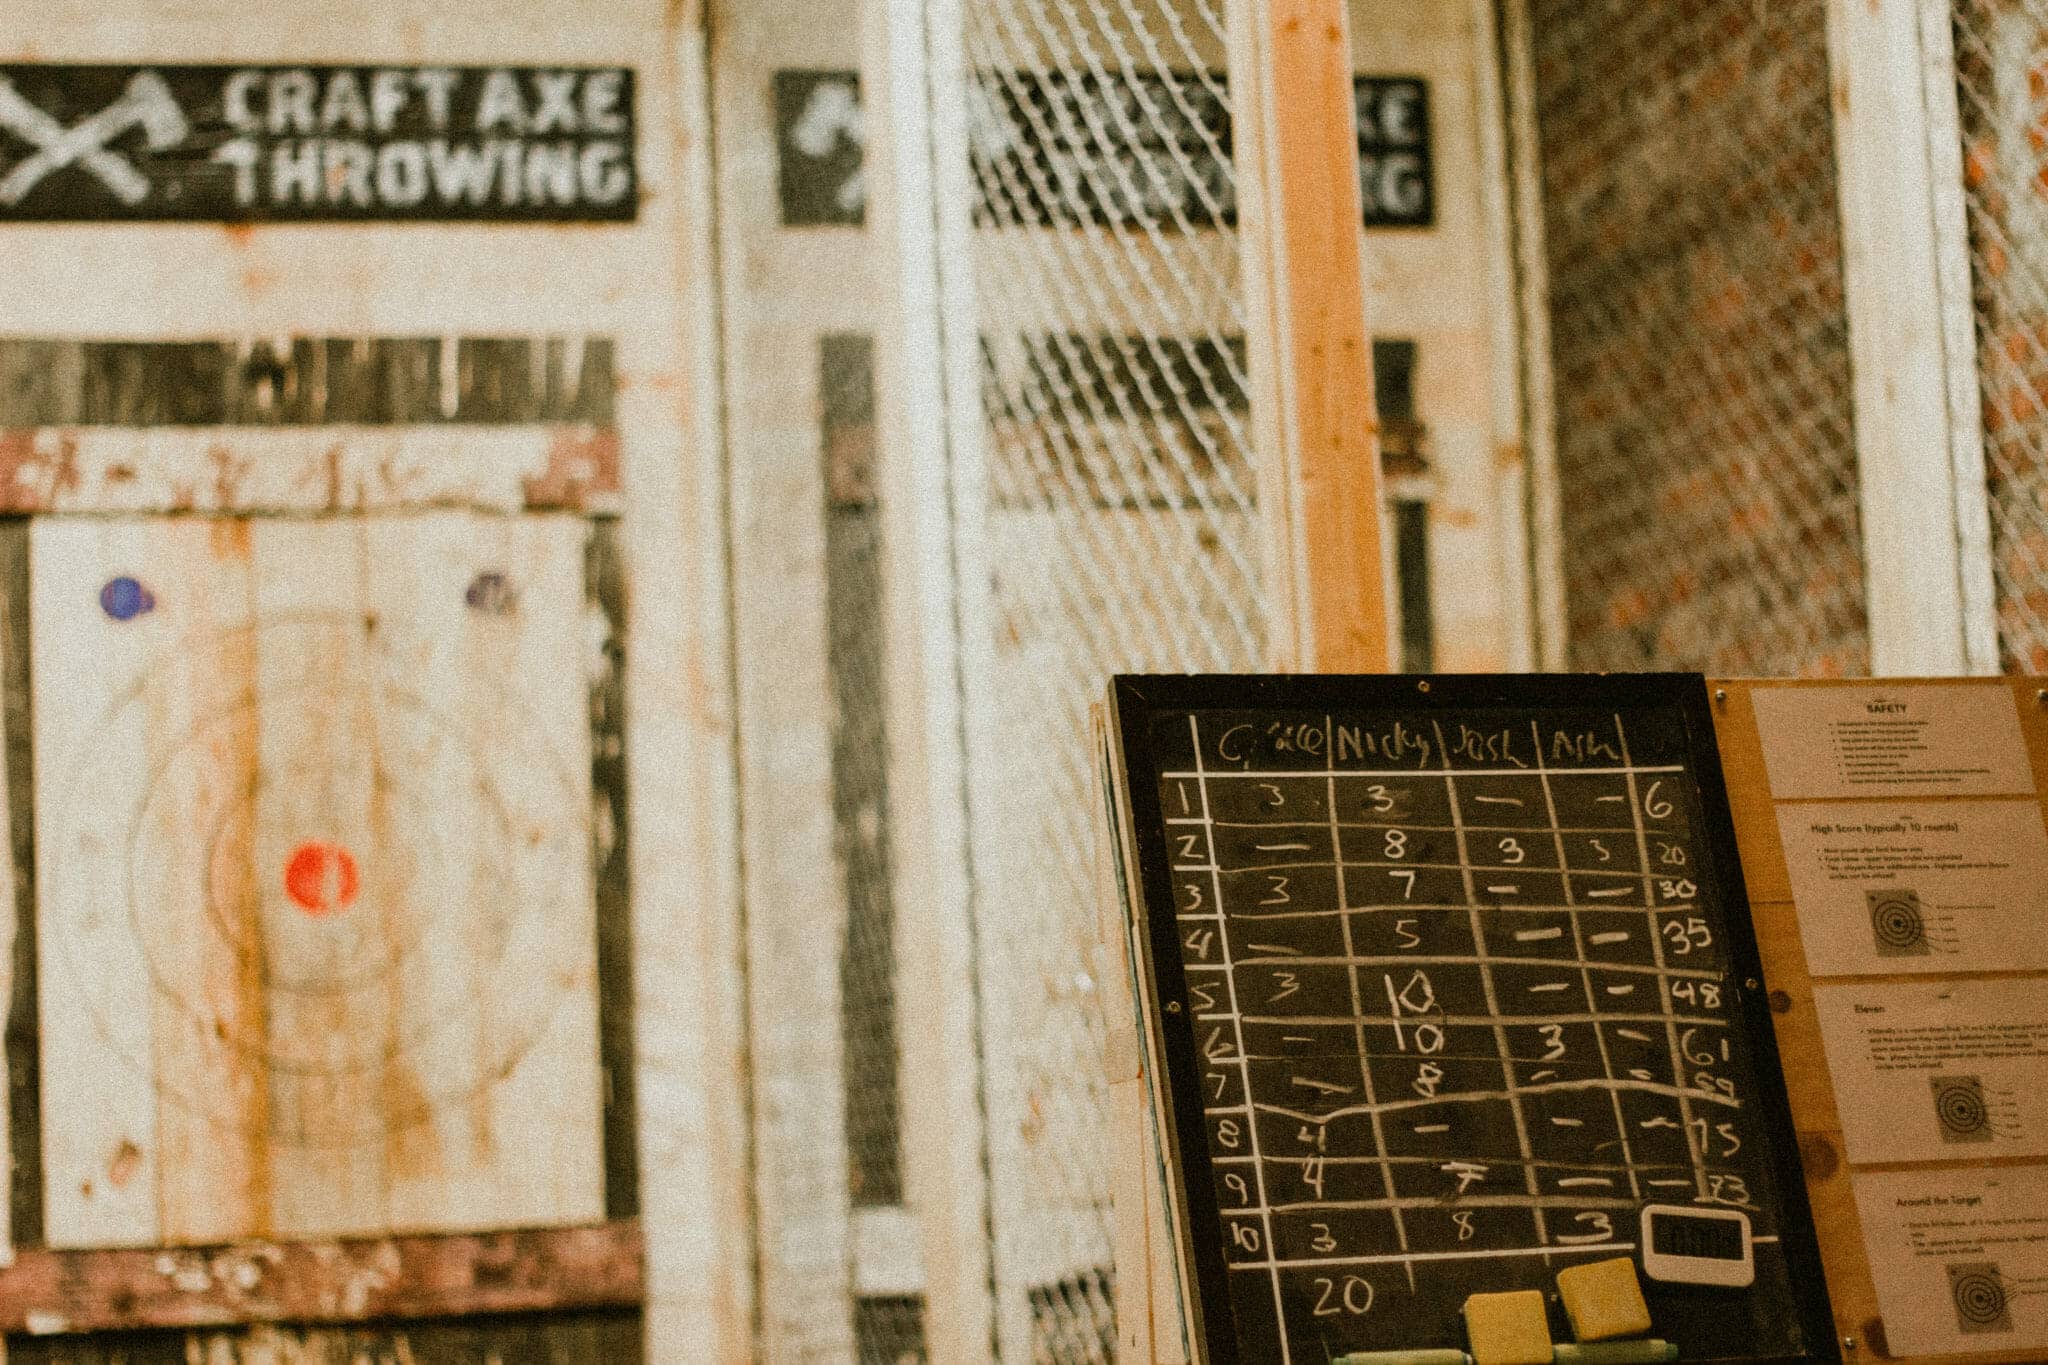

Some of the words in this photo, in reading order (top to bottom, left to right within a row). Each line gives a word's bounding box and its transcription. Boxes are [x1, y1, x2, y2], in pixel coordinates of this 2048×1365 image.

[222, 68, 460, 136] CRAFT
[475, 68, 628, 134] AXE
[210, 138, 632, 208] THROWING
[1866, 703, 1908, 714] SAFETY
[1178, 781, 1190, 815] 1
[1259, 783, 1285, 806] 3
[1367, 785, 1394, 811] 3
[1644, 780, 1673, 819] 6
[1384, 829, 1407, 858] 8
[1498, 837, 1525, 864] 3
[1588, 839, 1610, 861] 3
[1811, 823, 1833, 835] High
[1183, 884, 1202, 911] 3
[1258, 875, 1291, 906] 3
[1388, 869, 1415, 899] 7
[1184, 928, 1213, 959] 4
[1395, 919, 1421, 949] 5
[1662, 917, 1712, 955] 35
[1190, 982, 1221, 1012] 5
[1268, 972, 1300, 1003] 3
[1671, 980, 1721, 1009] 48
[1538, 1024, 1566, 1061] 3
[1205, 1072, 1227, 1100] 7
[1217, 1119, 1239, 1148] 8
[1224, 1173, 1248, 1205] 9
[1303, 1155, 1325, 1199] 4
[1231, 1221, 1260, 1251] 10
[1453, 1211, 1474, 1240] 8
[1556, 1211, 1613, 1243] 3
[1312, 1275, 1374, 1315] 20
